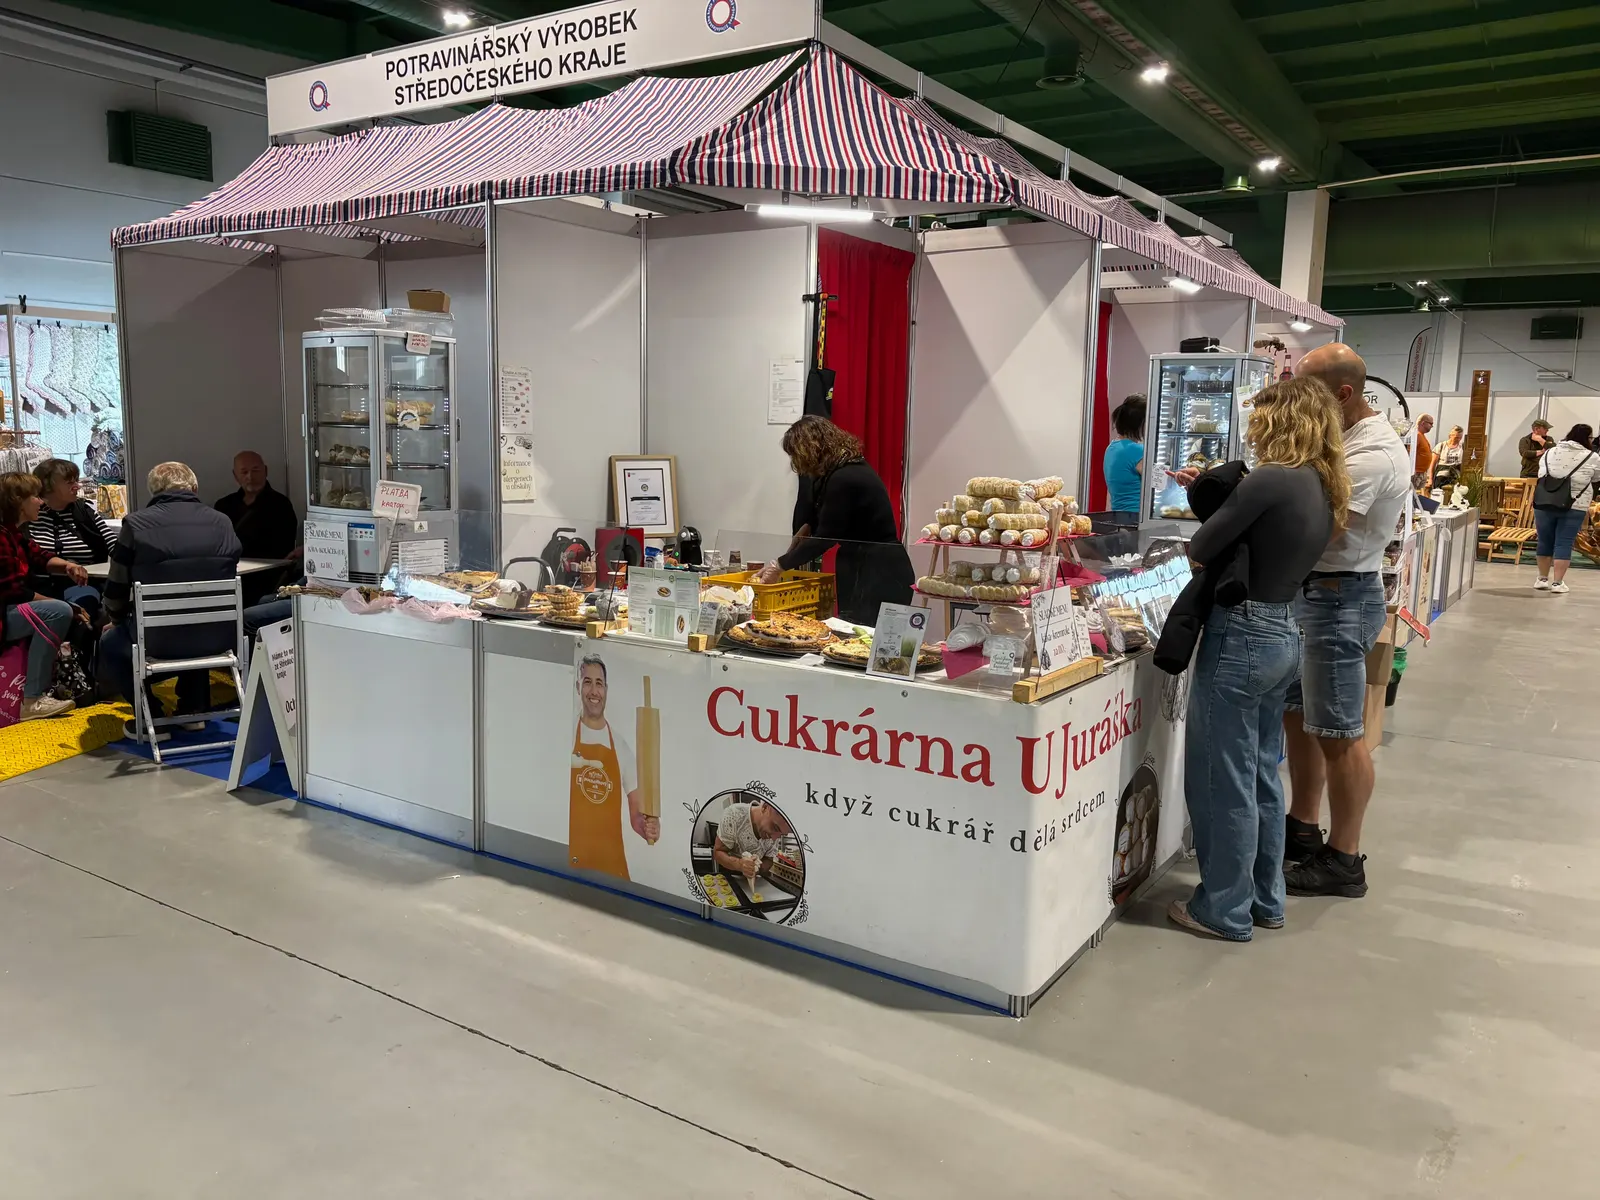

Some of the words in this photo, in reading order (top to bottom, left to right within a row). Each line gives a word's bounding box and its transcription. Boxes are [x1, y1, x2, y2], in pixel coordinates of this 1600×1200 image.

[386, 27, 532, 80] POTRAVINÁŘSKÝ
[538, 8, 638, 48] VÝROBEK
[394, 58, 553, 105] STŘEDOČESKÉHO
[559, 42, 627, 76] KRAJE
[380, 485, 409, 499] PLATBA
[706, 685, 995, 787] Cukrárna
[1015, 731, 1055, 796] U
[1054, 690, 1143, 800] Juráška
[805, 782, 874, 818] když
[888, 806, 995, 845] cukrář
[1009, 825, 1057, 853] dělá
[1061, 789, 1106, 834] srdcem
